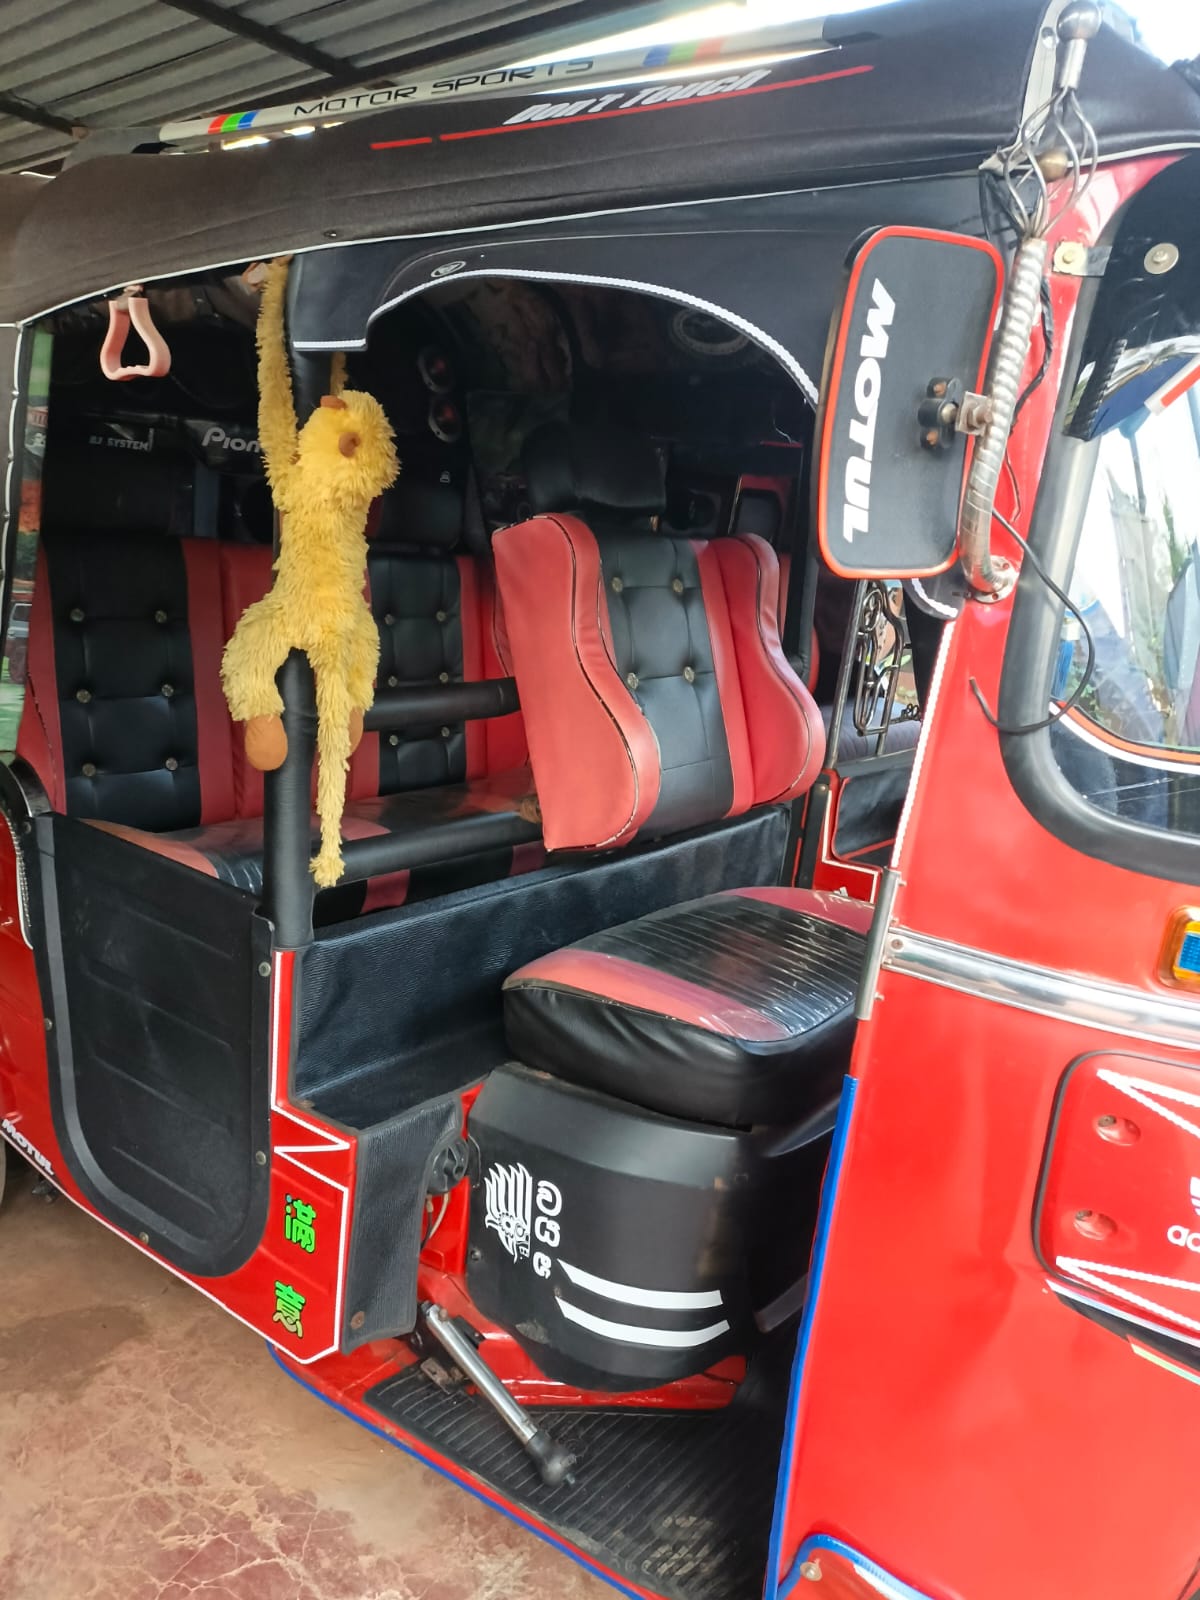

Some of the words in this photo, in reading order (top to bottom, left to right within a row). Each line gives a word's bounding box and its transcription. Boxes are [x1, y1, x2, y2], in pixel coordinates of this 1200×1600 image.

[293, 86, 418, 116] MOTOR
[431, 58, 594, 95] SPORTS
[201, 426, 262, 453] Pion
[843, 277, 896, 544] MOTUL
[1, 1118, 55, 1176] MOTUL
